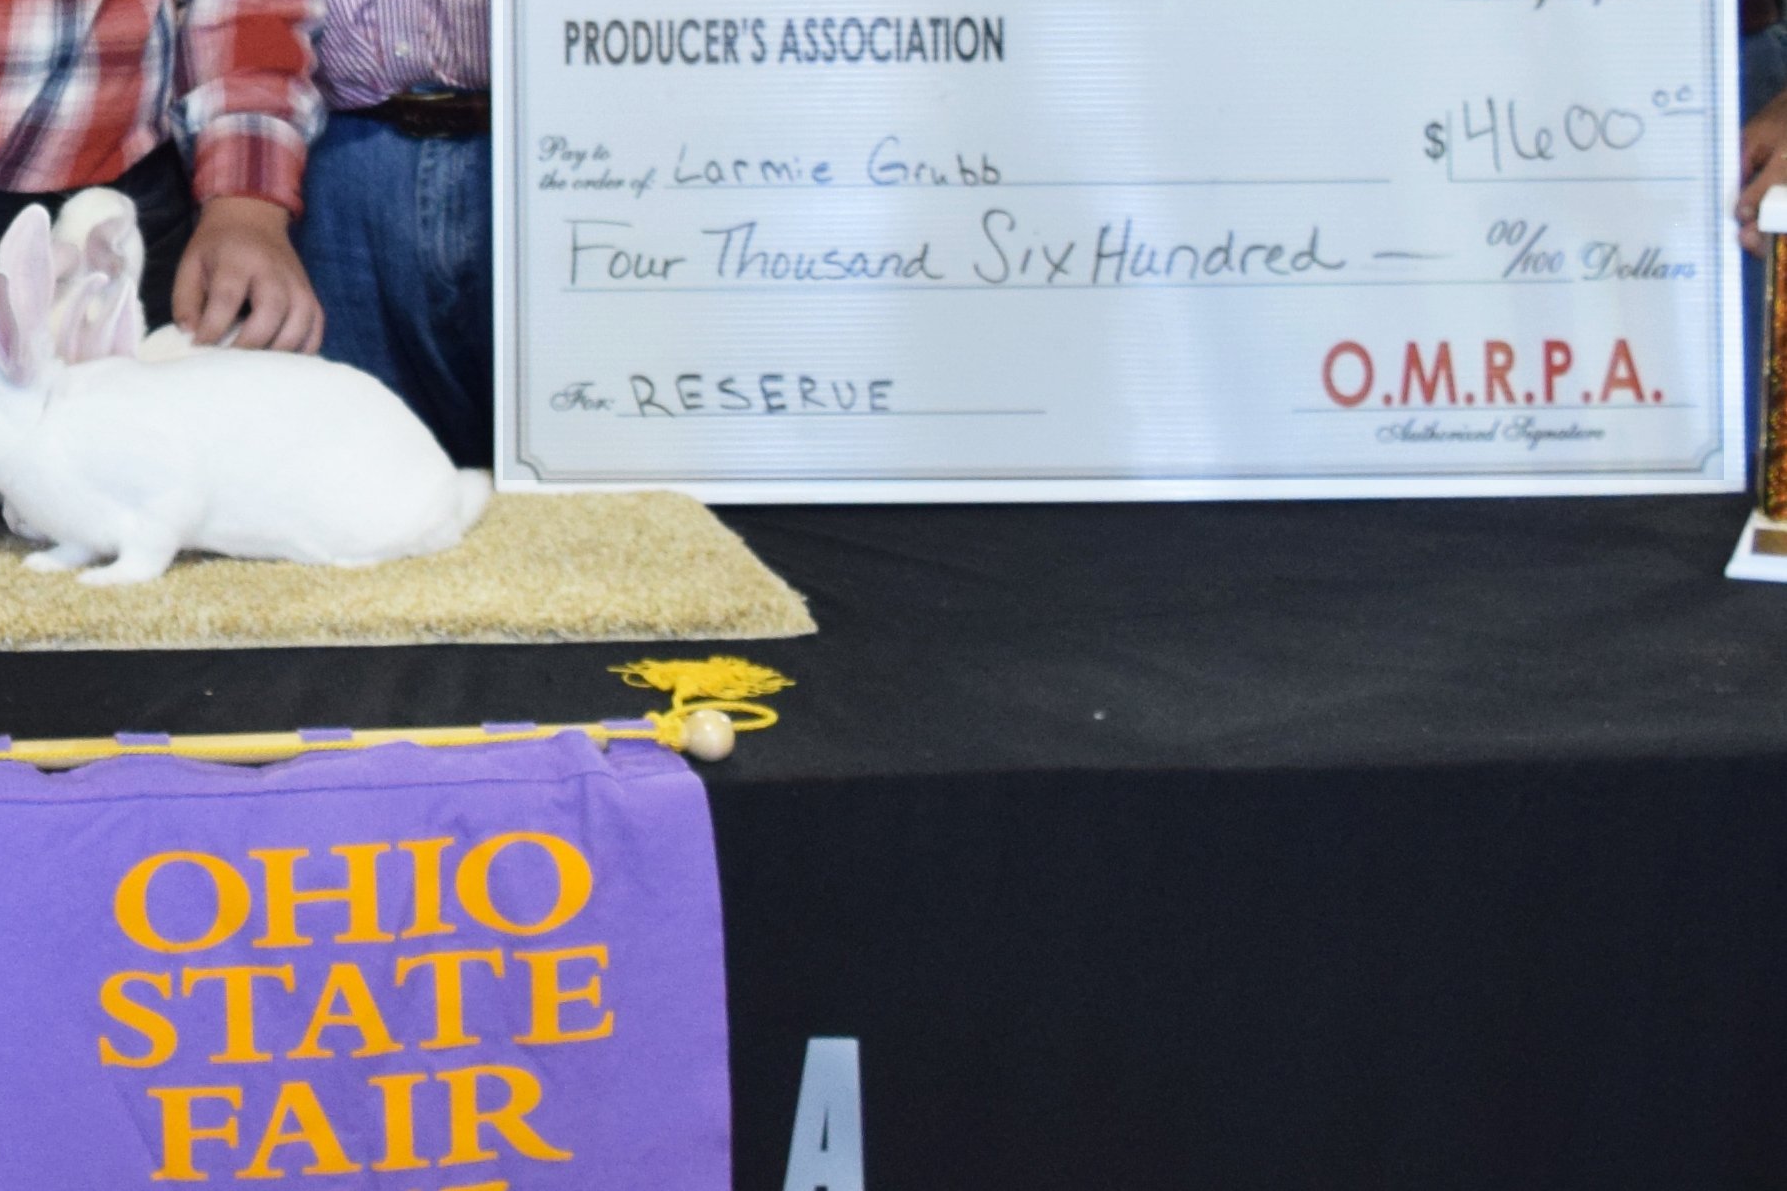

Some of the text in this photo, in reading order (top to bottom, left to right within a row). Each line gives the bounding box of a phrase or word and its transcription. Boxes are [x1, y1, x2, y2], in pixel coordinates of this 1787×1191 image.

[564, 16, 1006, 66] PRODUCER'S ASSOCIATION
[538, 135, 611, 170] Pay to
[538, 168, 568, 189] the
[572, 168, 625, 189] order
[867, 136, 1003, 187] Grubb
[563, 218, 687, 285] Four
[701, 220, 944, 282] Thousand
[973, 208, 1076, 285] Six
[1092, 217, 1347, 285] Hundred
[1580, 240, 1697, 281] Dollars
[1321, 338, 1666, 409] O.M.R.P.A.
[112, 830, 595, 953] OHIO
[98, 943, 615, 1069] STATE
[146, 1064, 574, 1183] FAIR
